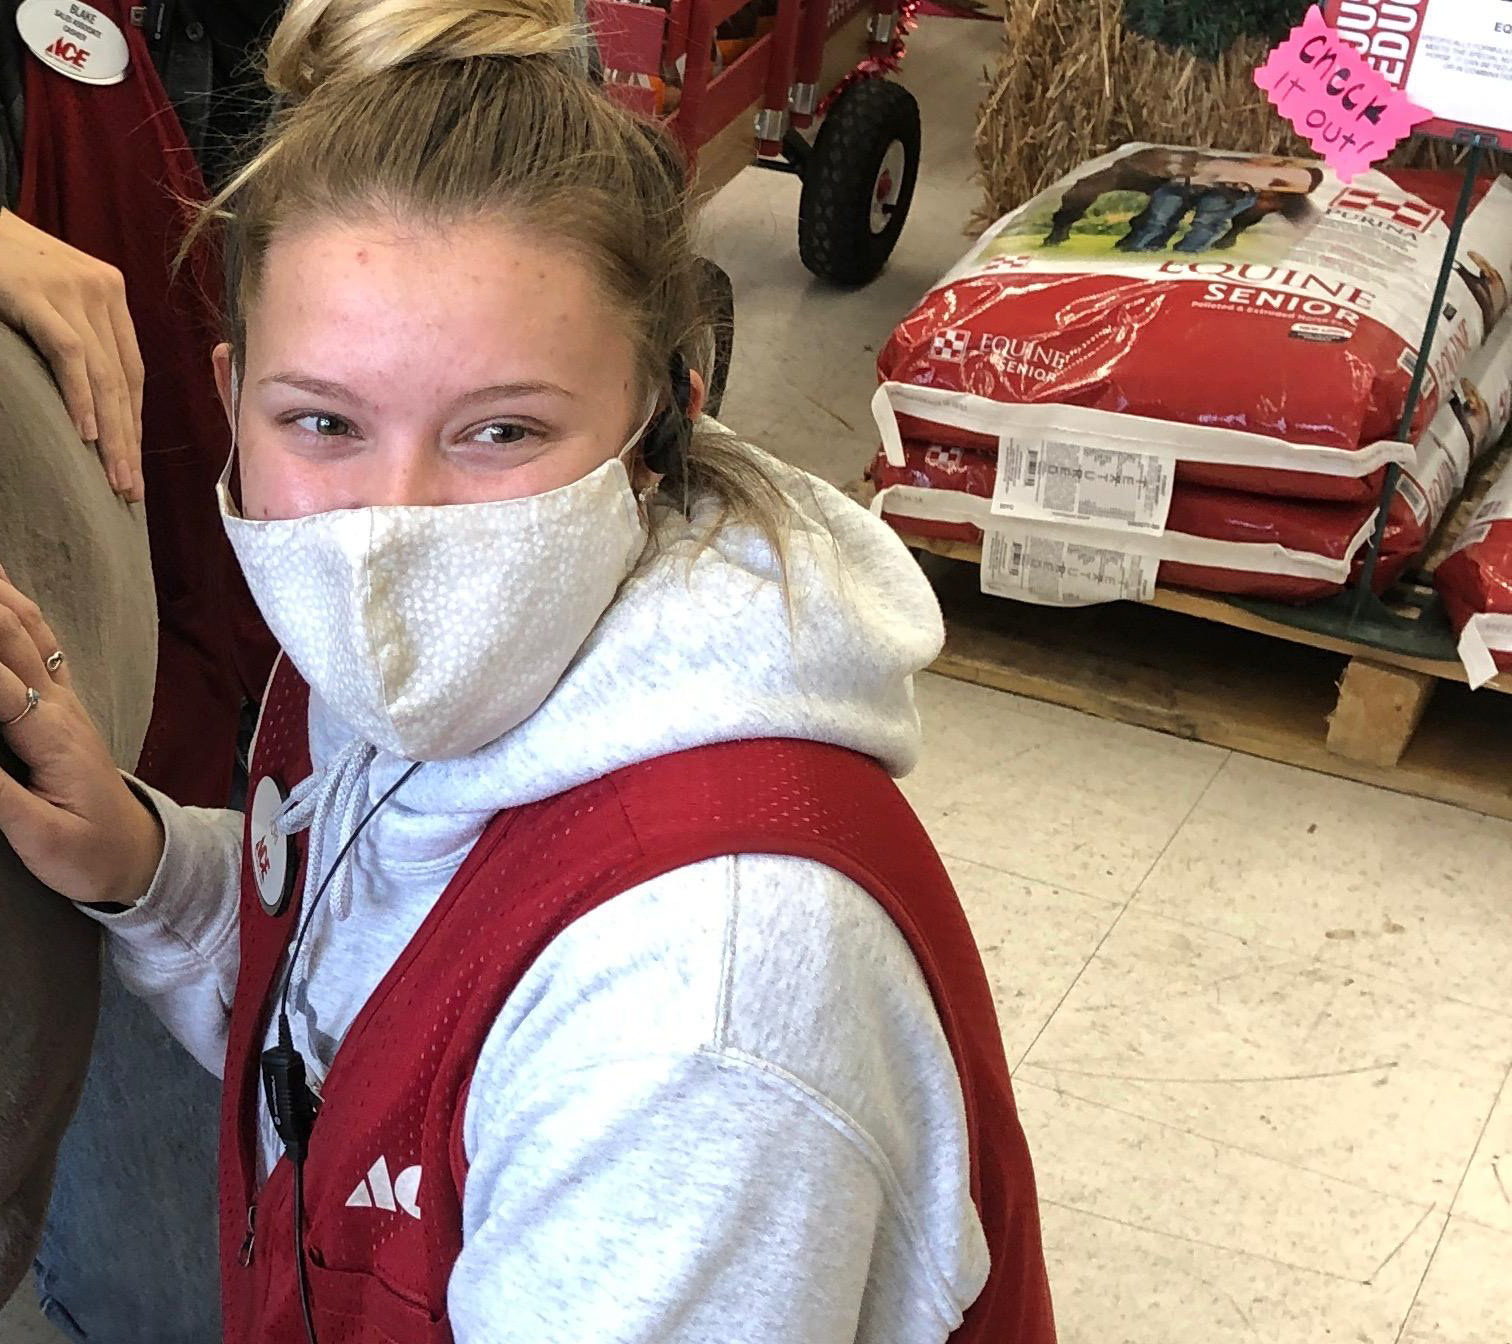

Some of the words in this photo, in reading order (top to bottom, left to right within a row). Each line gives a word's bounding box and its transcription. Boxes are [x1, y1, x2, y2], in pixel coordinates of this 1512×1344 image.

[69, 2, 97, 25] BLAKE
[45, 36, 92, 70] ACE
[1325, 207, 1418, 242] PURINA
[1158, 259, 1377, 310] EQUINE
[1203, 283, 1360, 330] SENIOR
[979, 333, 1066, 370] EQUINE
[997, 359, 1057, 383] SENIOR
[345, 1155, 422, 1220] AC
